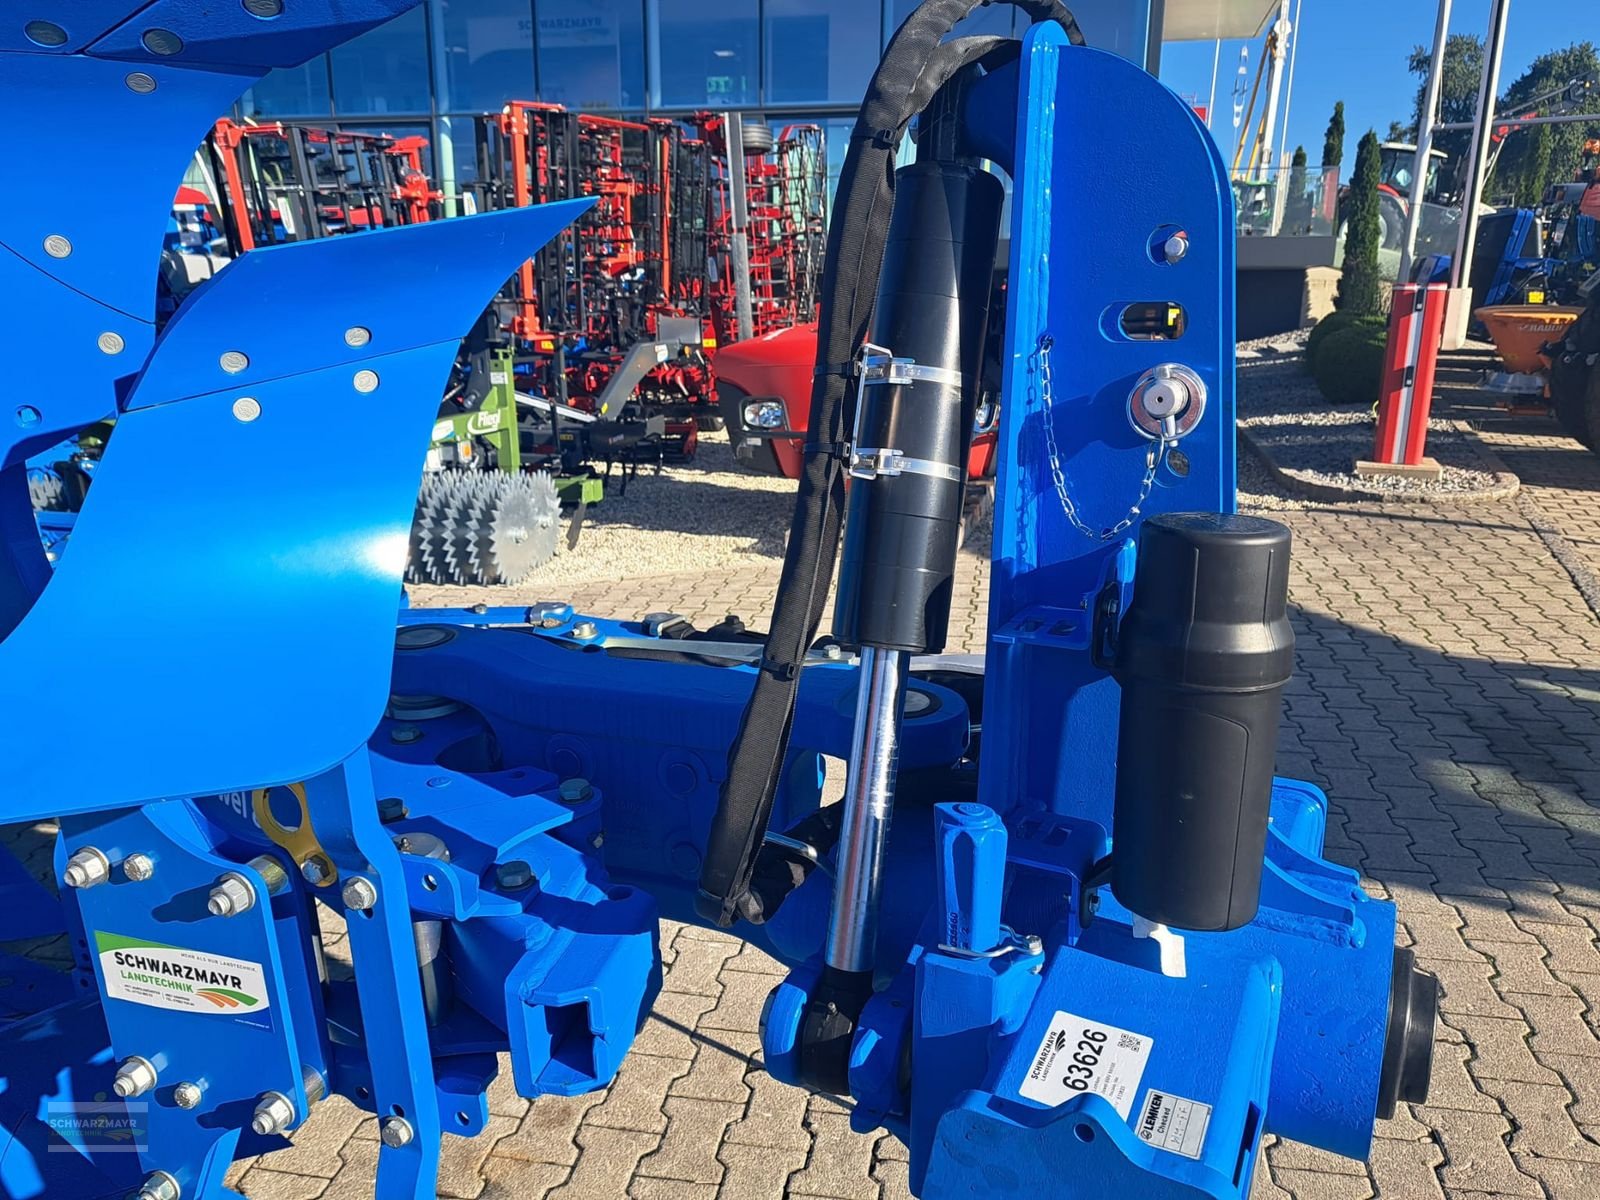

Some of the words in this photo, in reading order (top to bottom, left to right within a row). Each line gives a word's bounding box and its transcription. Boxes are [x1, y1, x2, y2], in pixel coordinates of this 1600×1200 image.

[114, 951, 242, 990] SCHWARZMAYR
[120, 969, 194, 994] LANDTECHNIK
[1031, 1031, 1058, 1080] SCHWARZMAYR
[1041, 1052, 1057, 1082] LANDTECHNIK
[1062, 1029, 1108, 1091] 63626
[1143, 1094, 1164, 1131] LEMKEN
[1157, 1107, 1171, 1134] Checked
